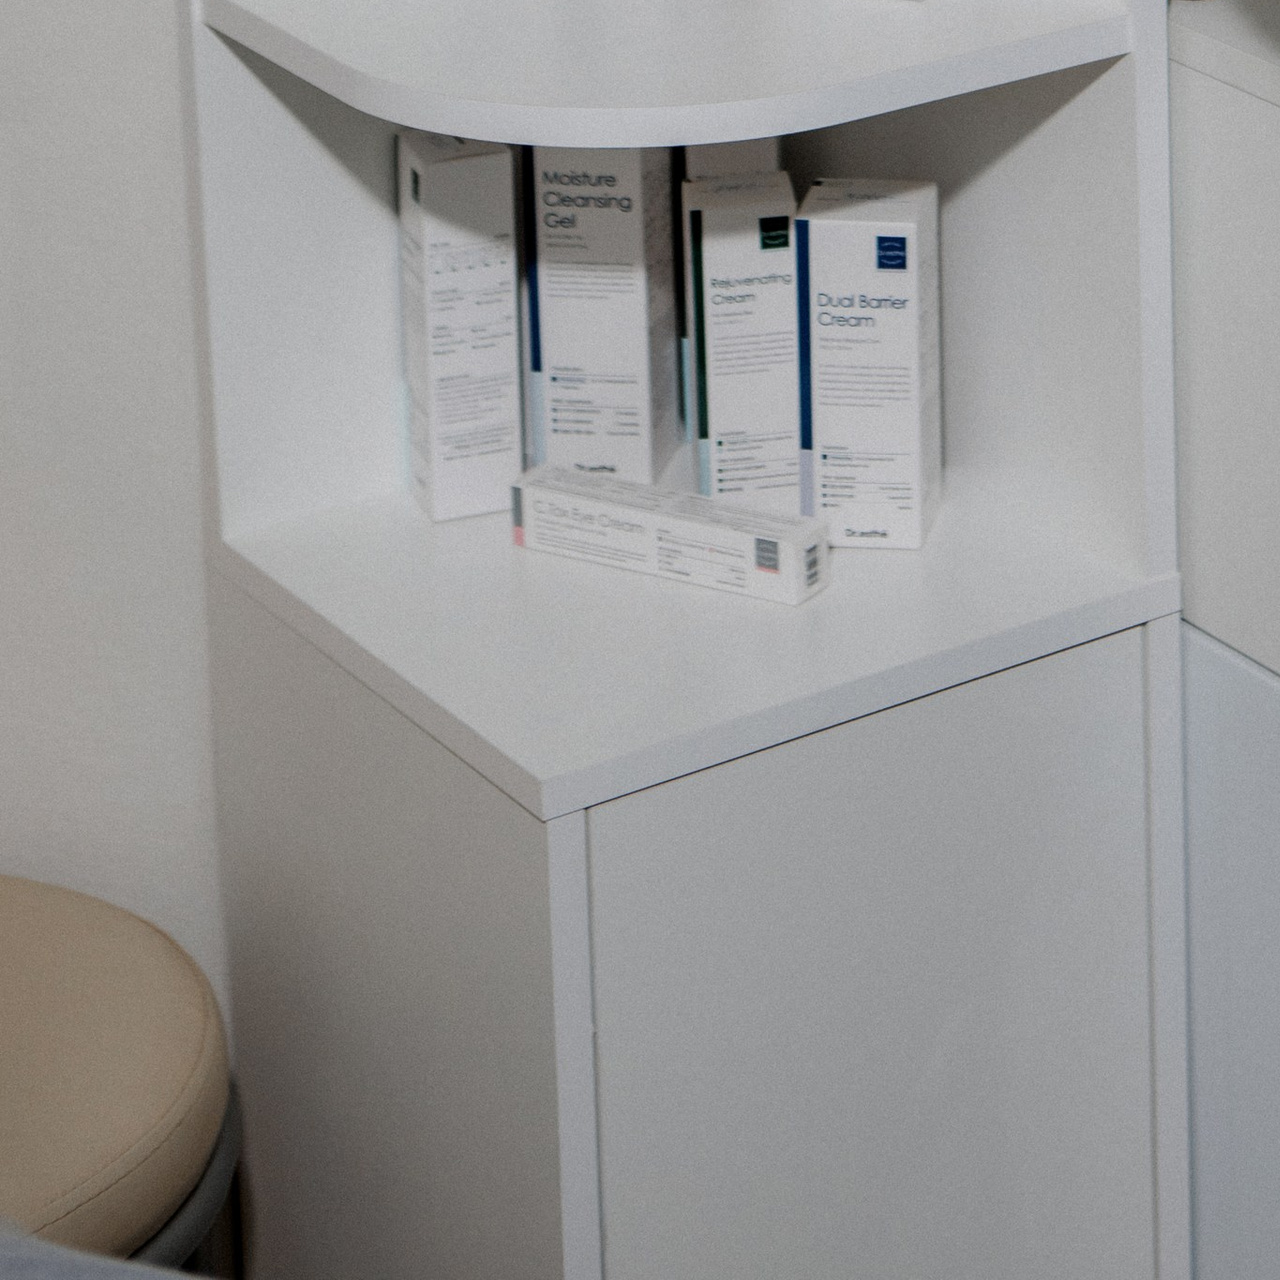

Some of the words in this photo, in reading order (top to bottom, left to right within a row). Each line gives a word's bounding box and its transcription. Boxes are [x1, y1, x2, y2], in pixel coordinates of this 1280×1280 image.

[541, 170, 617, 188] Moisture
[542, 191, 632, 212] Cleansing
[543, 212, 577, 228] Gel
[710, 272, 793, 290] Rejuvenating
[711, 292, 757, 306] Cream
[816, 293, 855, 308] Dual
[858, 294, 910, 310] Barrier
[817, 312, 876, 328] Cream
